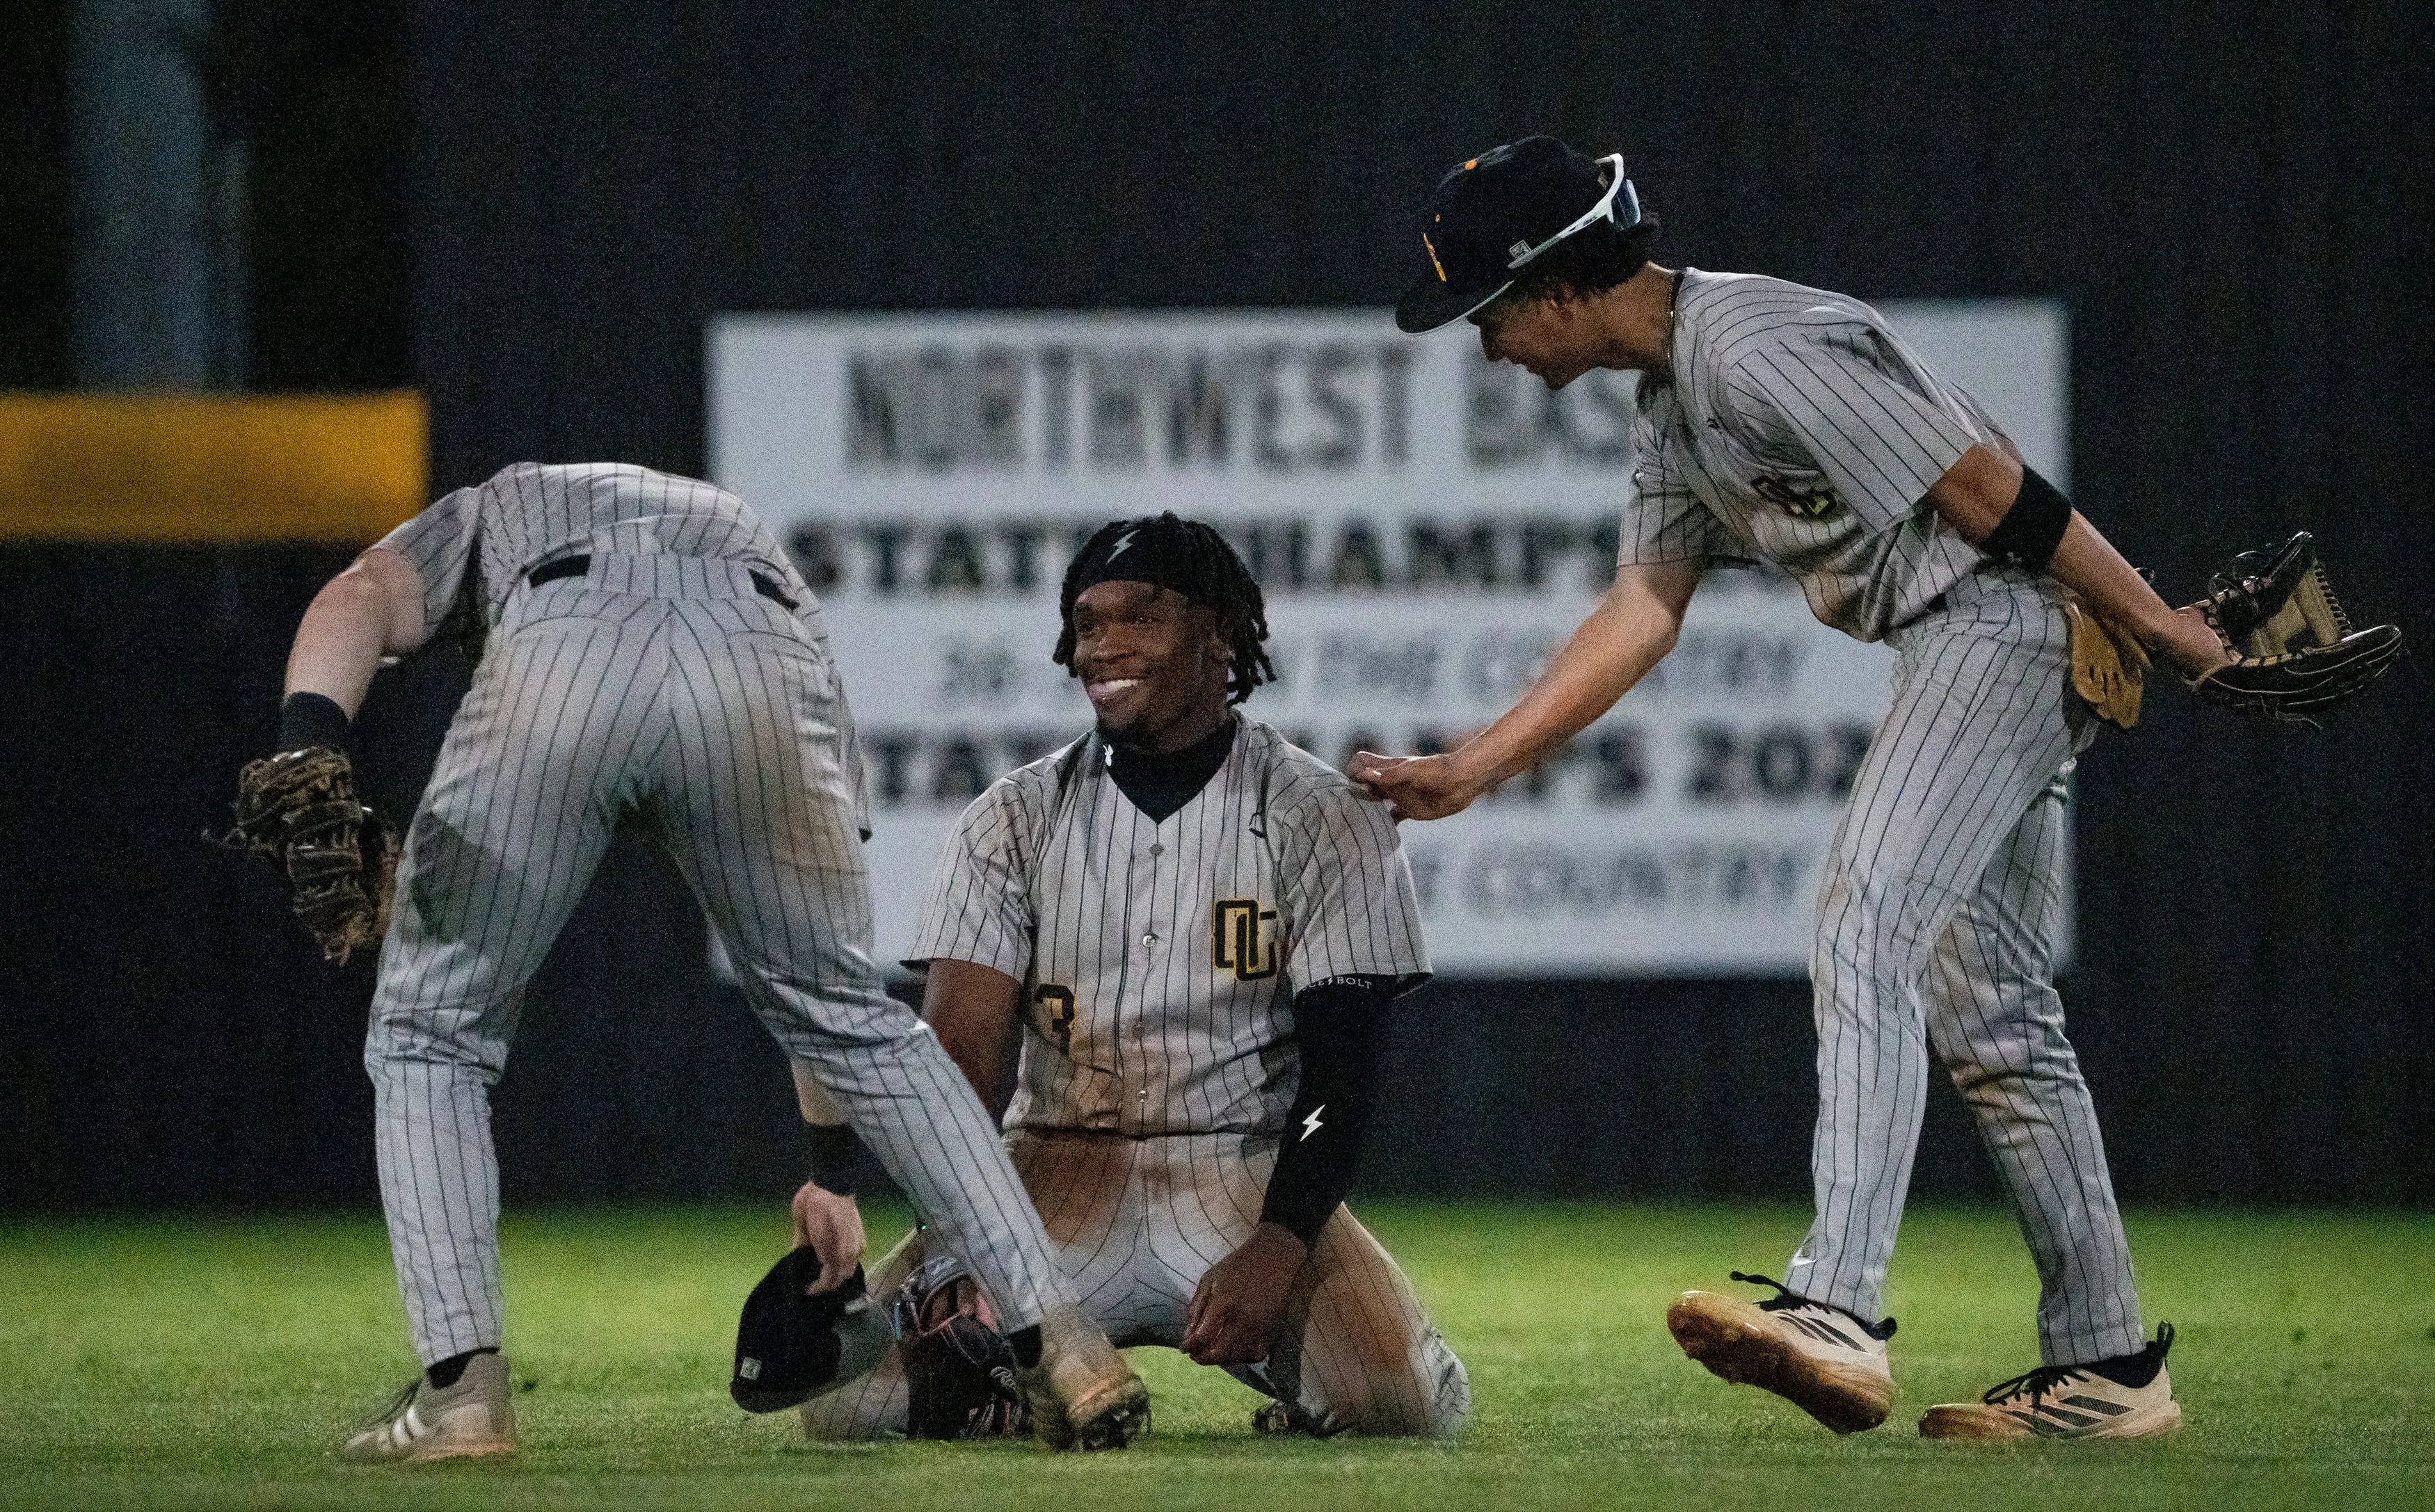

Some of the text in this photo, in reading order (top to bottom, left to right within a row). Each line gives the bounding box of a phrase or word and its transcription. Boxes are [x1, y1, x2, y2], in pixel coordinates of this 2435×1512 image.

[846, 344, 1631, 469] NORTHWEST BAS
[788, 516, 1620, 595] STAT HAMP
[1461, 629, 1809, 695] COTRY
[1685, 725, 1877, 801] 202
[1459, 843, 1810, 919] COUNTRY
[1336, 976, 1372, 990] BOLT
